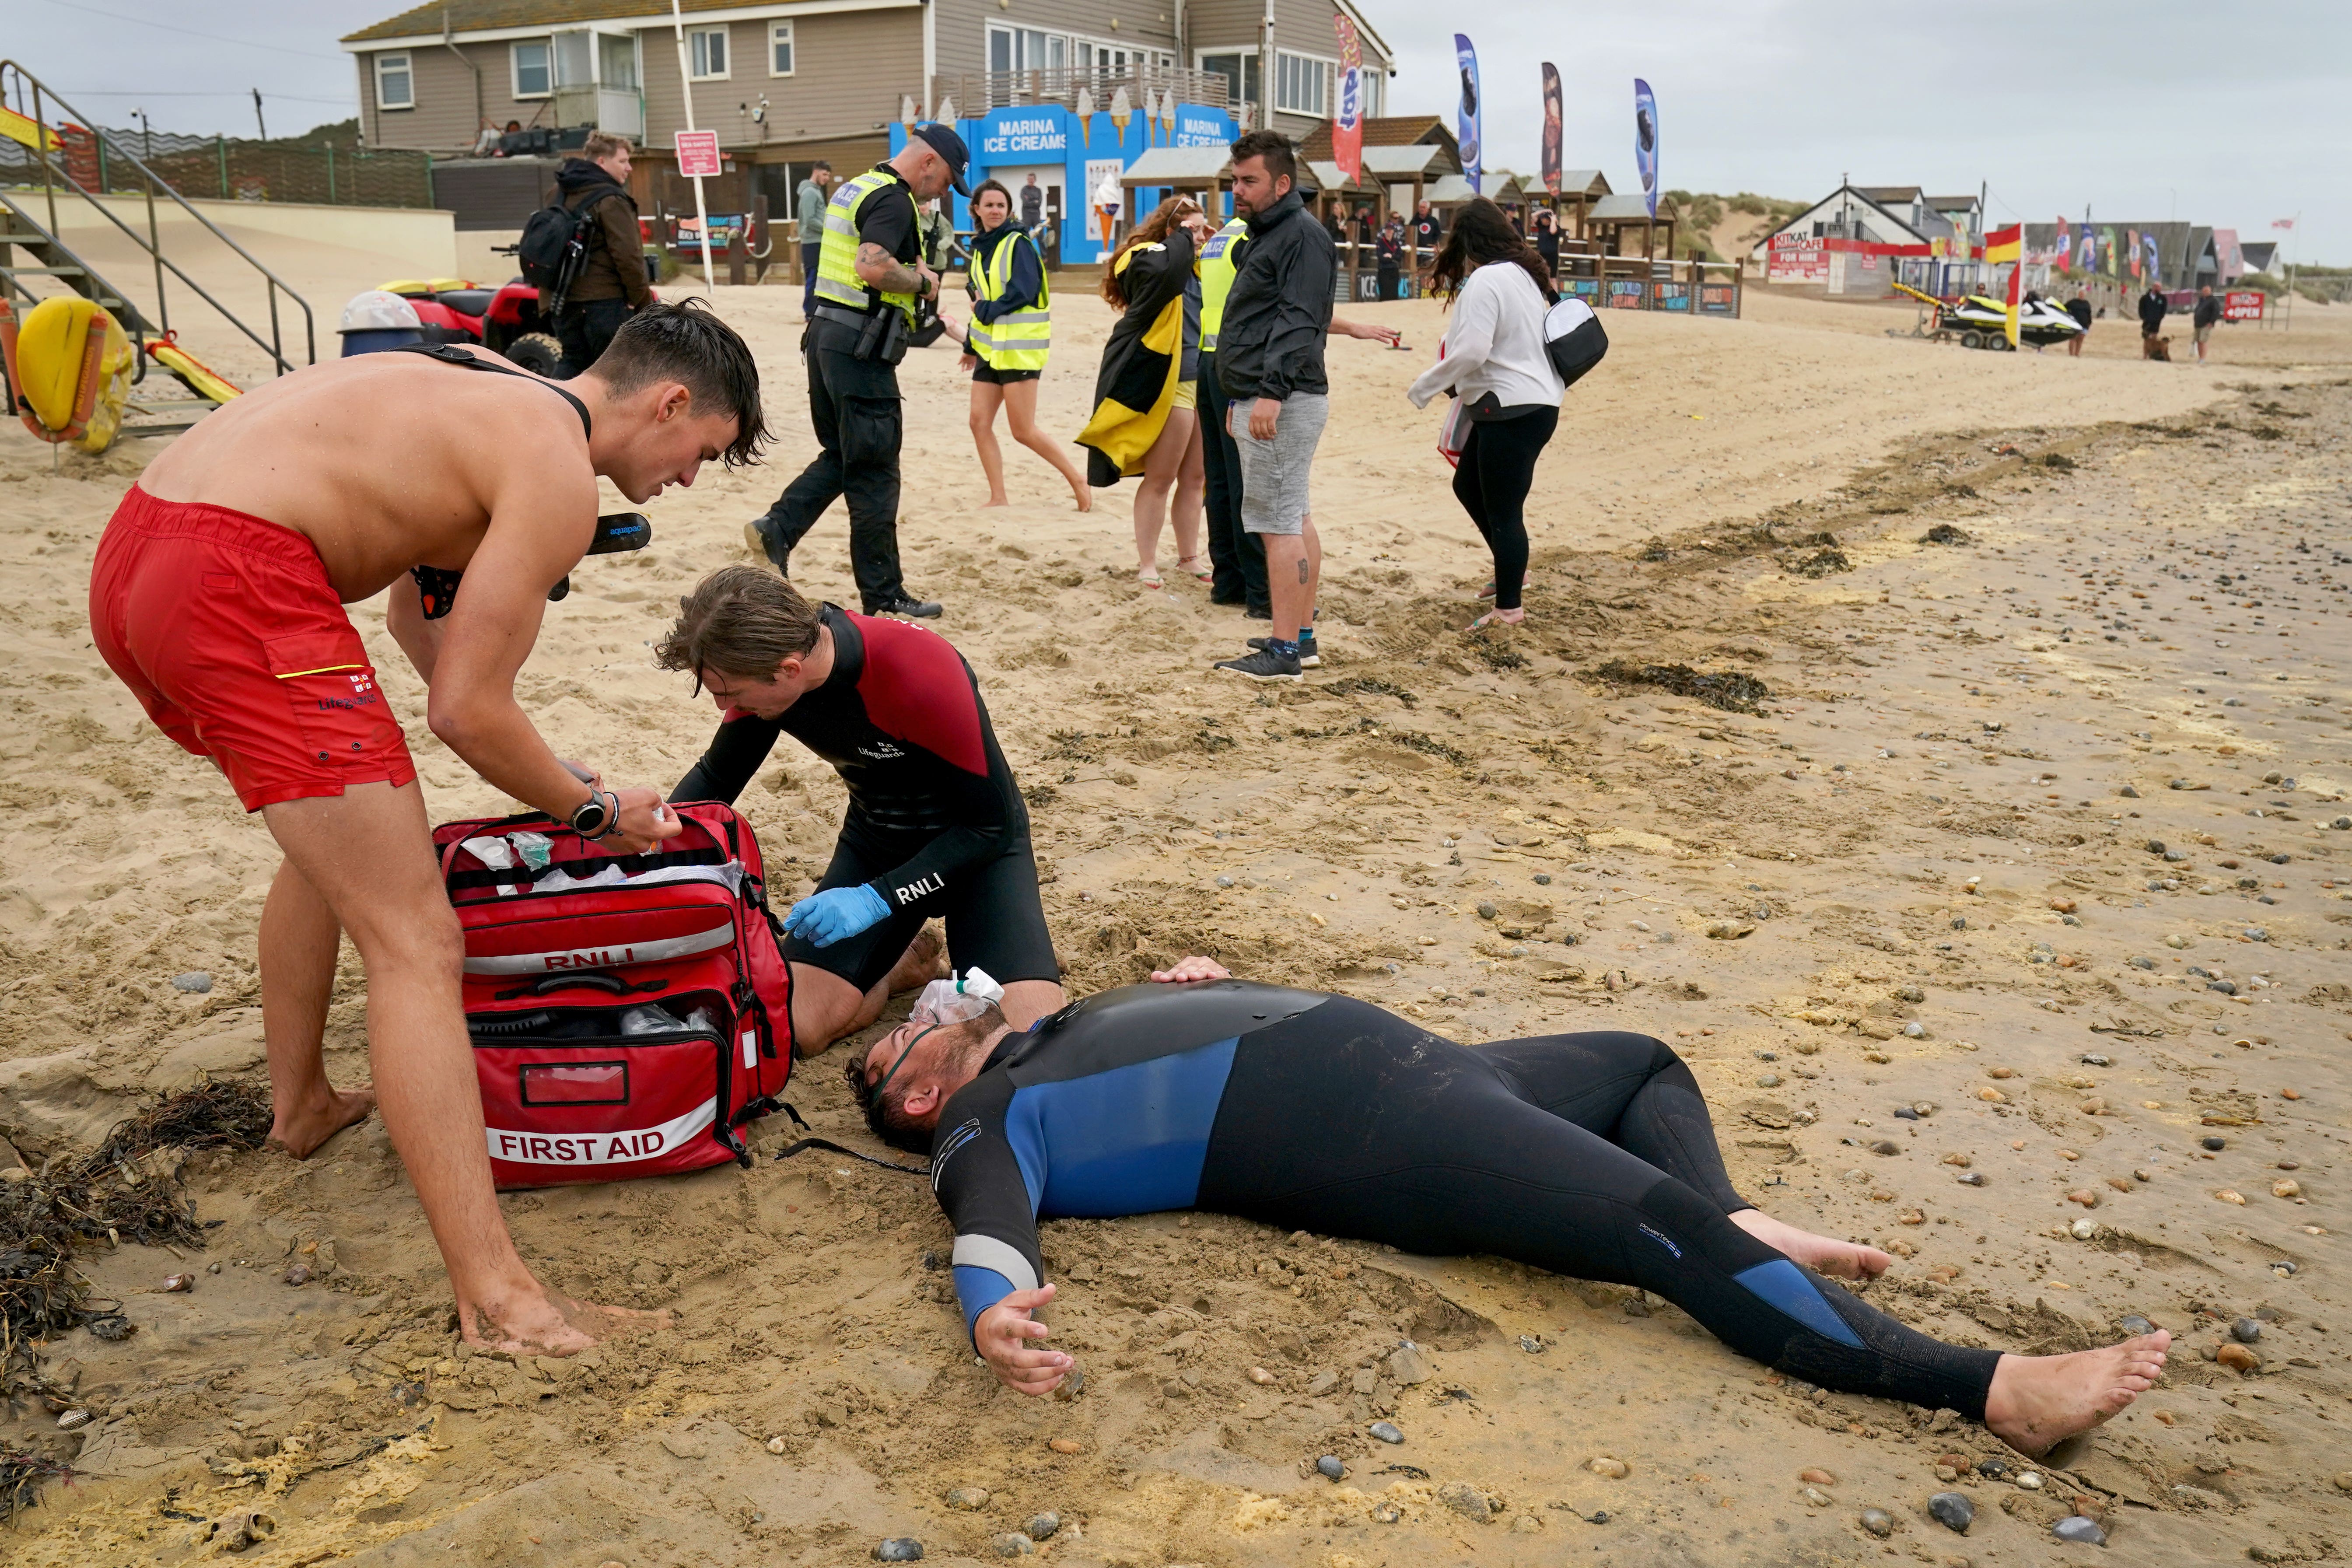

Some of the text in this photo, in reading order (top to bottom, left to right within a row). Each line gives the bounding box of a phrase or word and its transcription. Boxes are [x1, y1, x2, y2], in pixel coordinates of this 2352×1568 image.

[999, 119, 1055, 136] MARINA
[1184, 118, 1221, 136] MARINA
[984, 133, 1066, 153] ICE CREAMS
[1780, 253, 1817, 262] FOR HIRE
[1361, 276, 1376, 298] ICE
[2234, 306, 2260, 318] OPEN
[610, 525, 642, 536] aquapac
[318, 692, 376, 711] Lifeguards
[858, 747, 905, 759] Lifeguards
[896, 872, 945, 905] RNLI
[544, 948, 634, 970] RNLI
[500, 1131, 665, 1161] FIRST AID
[1639, 1222, 1671, 1245] PowerTex
